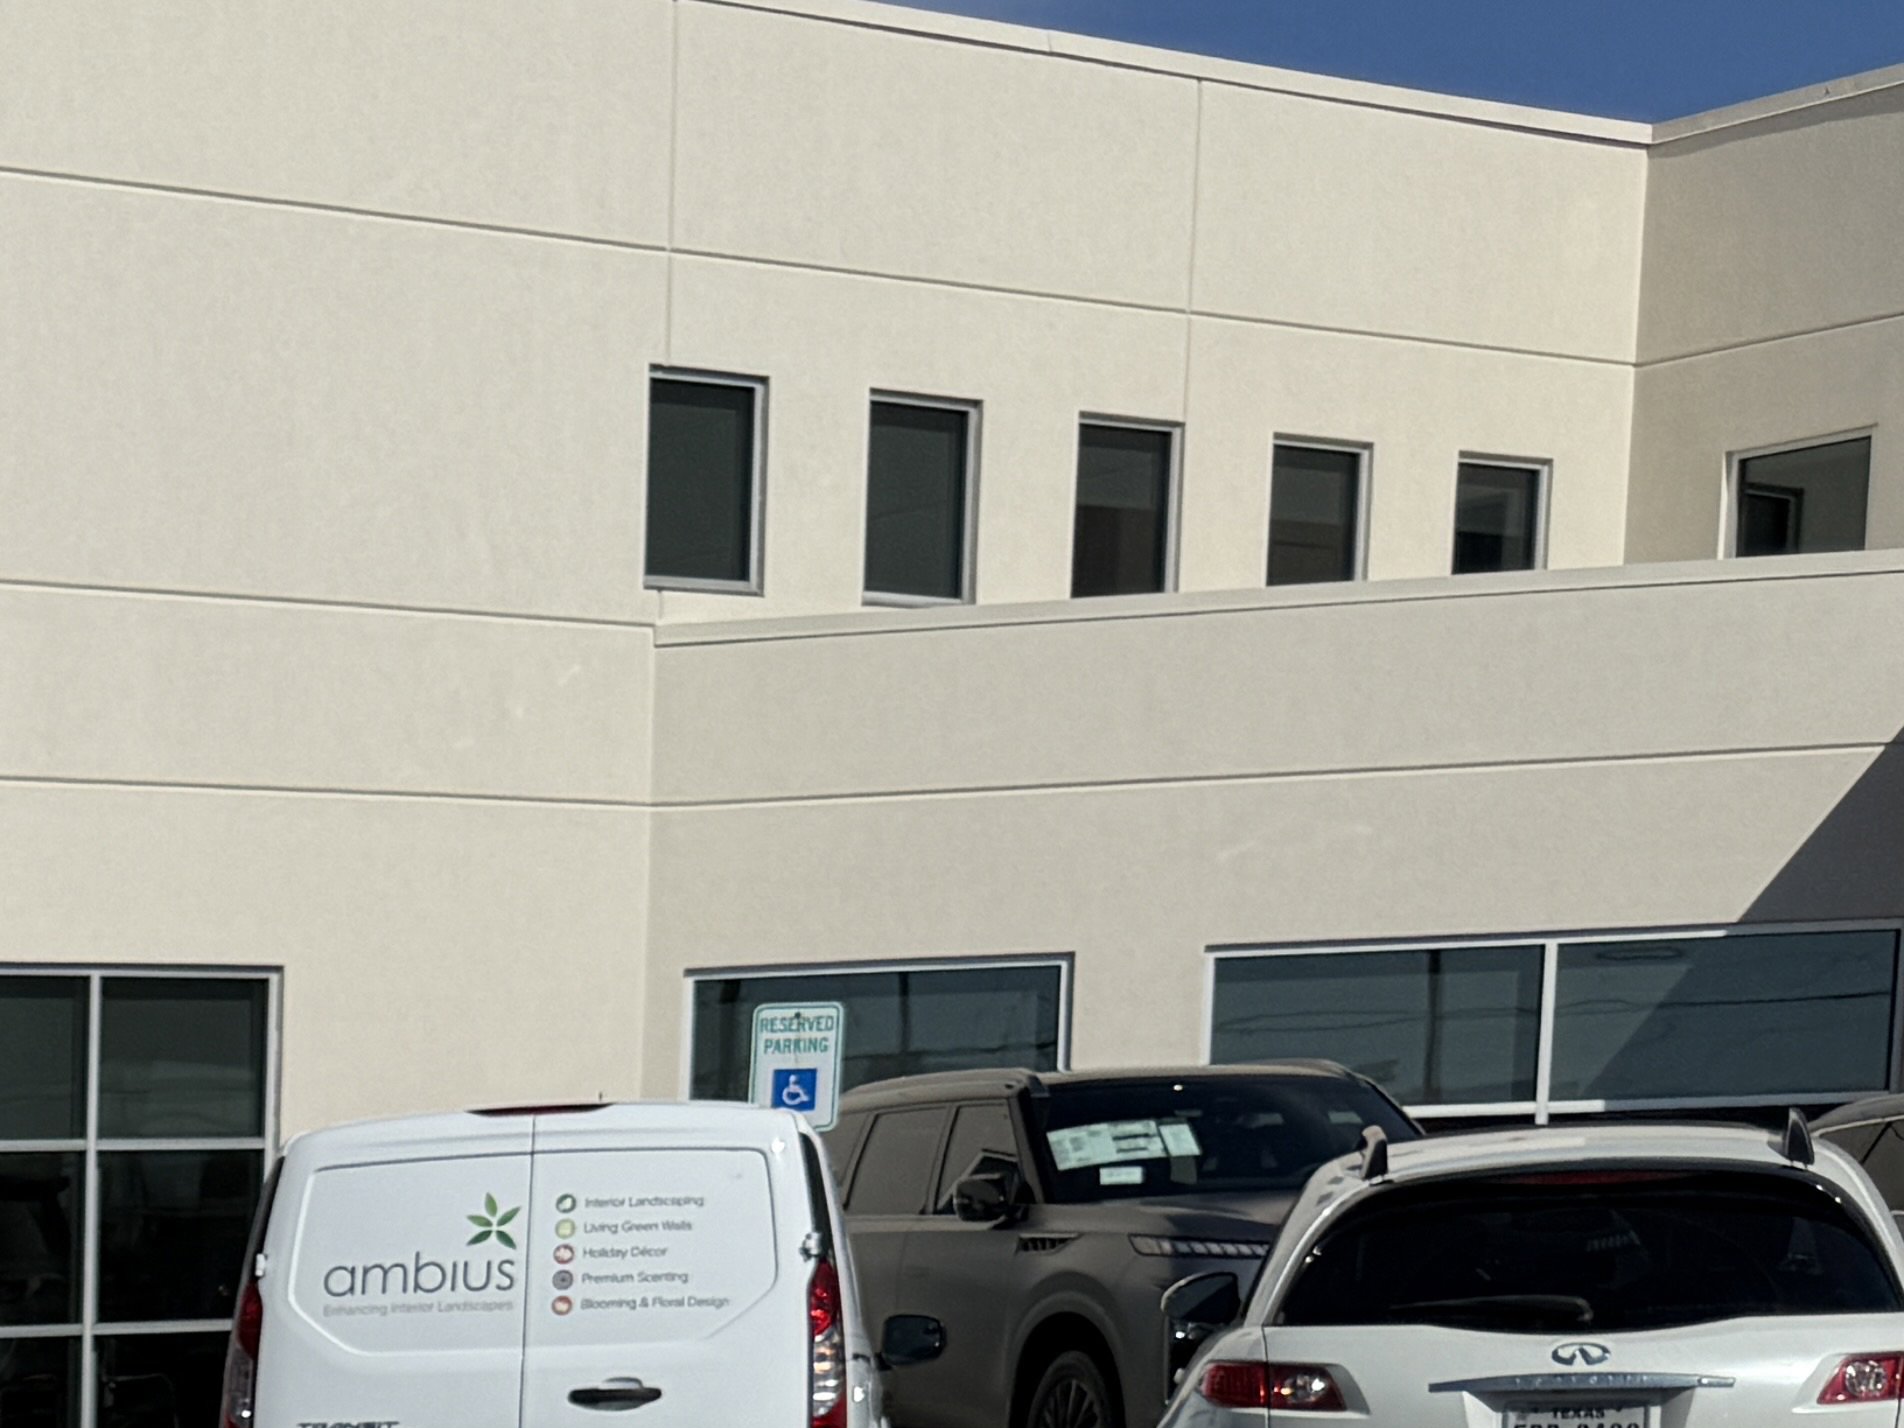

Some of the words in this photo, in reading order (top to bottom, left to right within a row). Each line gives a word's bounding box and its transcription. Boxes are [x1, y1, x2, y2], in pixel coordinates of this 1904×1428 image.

[758, 1015, 834, 1033] RESERVED
[763, 1037, 829, 1054] PARKING
[323, 1250, 517, 1298] ambius
